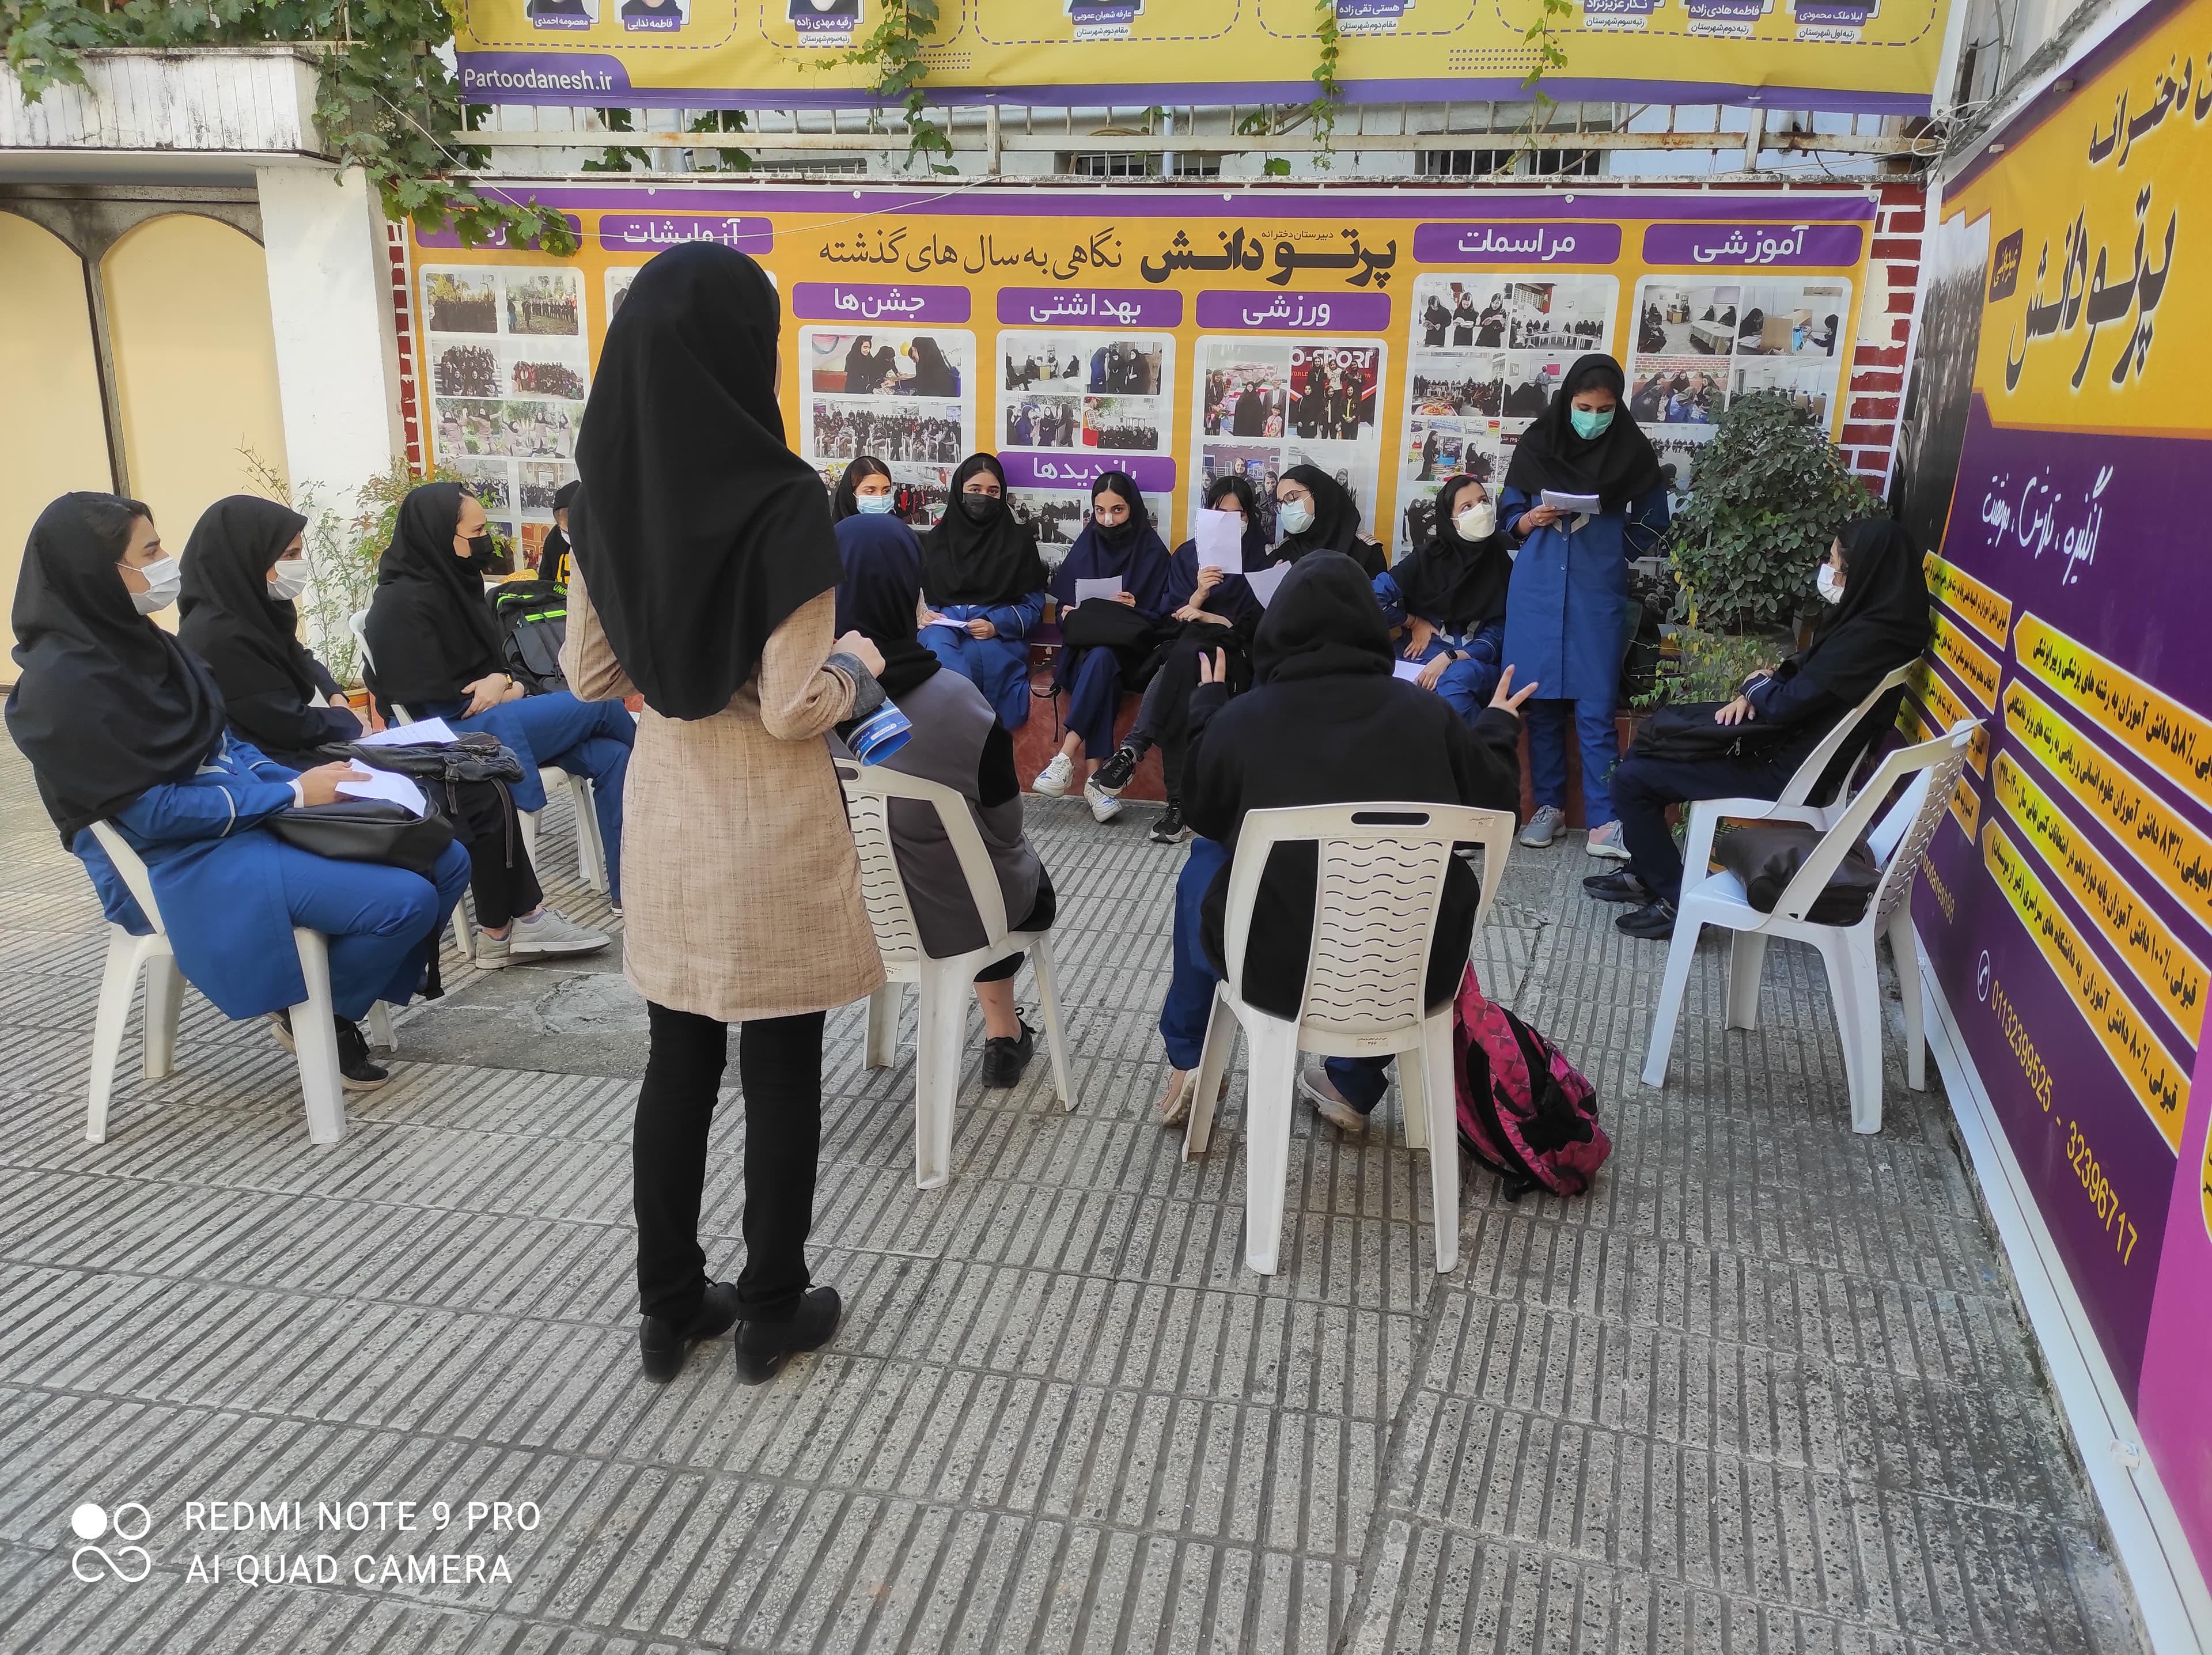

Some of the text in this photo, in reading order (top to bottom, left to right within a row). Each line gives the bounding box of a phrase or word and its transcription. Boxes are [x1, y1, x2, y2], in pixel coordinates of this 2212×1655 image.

[535, 17, 588, 28] معصومه احمدی
[627, 18, 673, 31] فاطمه ندایی
[797, 16, 852, 29] رقیه مهدی زاده
[1095, 10, 1115, 21] شعبان
[1115, 10, 1132, 20] عارفه
[1339, 3, 1400, 16] هستی تقی زاده
[1586, 17, 1645, 28] رتبه سوم شهرستان
[1691, 4, 1759, 17] فاطمه هادی زاده
[1800, 12, 1862, 21] لیلا ملک محمودی
[801, 35, 827, 44] شهرستان
[1076, 27, 1103, 37] شهرستان
[1340, 20, 1397, 32] مقام دوم شهرستان
[1691, 22, 1749, 35] رتبه دوم شهرستان
[1800, 29, 1855, 40] رتبه اول شهرستان
[464, 68, 612, 90] Partoodanesh.ir
[2089, 54, 2191, 168] دخترانه
[1262, 230, 1334, 241] دبیرستان دخترانه
[1458, 228, 1575, 261] مراسمات
[1693, 225, 1809, 263] آموزشی
[820, 226, 1396, 289] پرتو دانش نگاهی به سال های گذشته
[2006, 183, 2176, 391] پرتو دانش
[1029, 293, 1141, 324] بهداشتی
[1243, 294, 1331, 327] ورزشی
[2062, 657, 2081, 691] پزشکی
[2081, 669, 2094, 694] های
[2096, 679, 2109, 711] رشته
[2112, 691, 2119, 717] به
[2033, 714, 2043, 739] های
[2118, 694, 2149, 730] آموزان
[2044, 726, 2054, 753] رشته
[2146, 713, 2170, 745] دانش
[2059, 742, 2075, 774] ریاضی
[2080, 759, 2101, 790] انسانی
[2018, 785, 2027, 809] سال
[2098, 777, 2113, 804] علوم
[2113, 789, 2141, 825] آموزان
[2048, 822, 2069, 857] امتحانات
[2137, 812, 2159, 844] دانش
[2066, 848, 2075, 868] در
[1921, 851, 1955, 925] toodanesh98
[2073, 857, 2097, 895] دوازدهم
[2181, 855, 2212, 906] اهیابی
[2023, 889, 2043, 923] سراسری
[2097, 880, 2108, 911] پایه
[2106, 892, 2133, 930] آموزان
[2042, 914, 2054, 937] های
[2130, 919, 2149, 953] دانش
[2055, 927, 2075, 968] دانشگاه
[2076, 961, 2082, 979] به
[2083, 974, 2109, 1013] آموزان
[2170, 967, 2198, 1010] قبولی
[2108, 1008, 2128, 1044] دانش
[2149, 1068, 2178, 1115] قبولی
[1991, 979, 2053, 1112] 01132399525
[2067, 1120, 2138, 1267] 32396717
